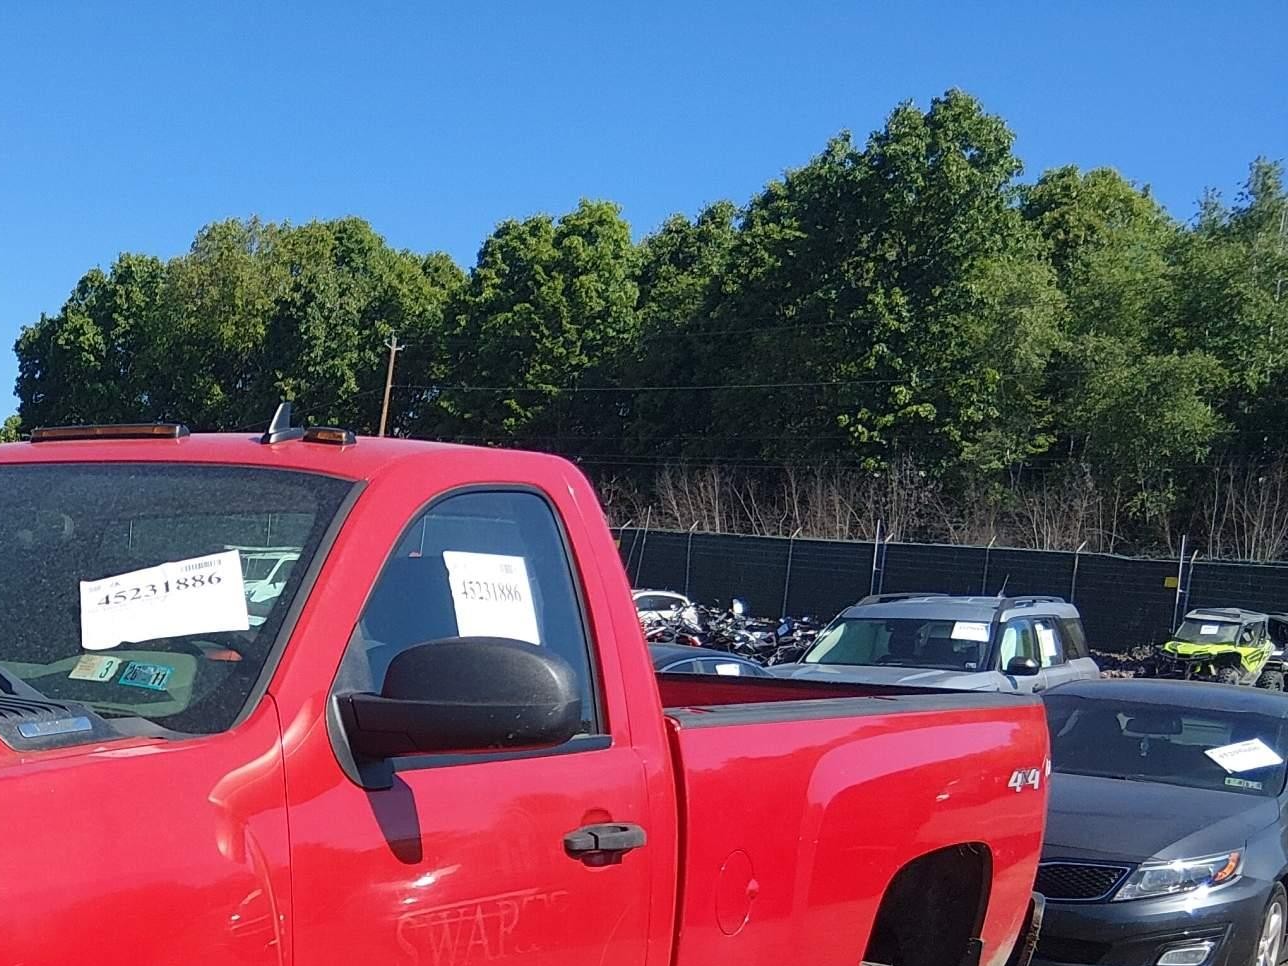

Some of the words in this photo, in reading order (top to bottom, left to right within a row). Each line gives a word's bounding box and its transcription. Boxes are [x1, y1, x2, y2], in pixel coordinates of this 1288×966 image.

[97, 572, 221, 605] 45231886
[462, 580, 522, 602] 45231886
[99, 660, 114, 679] 3
[152, 671, 167, 686] 11
